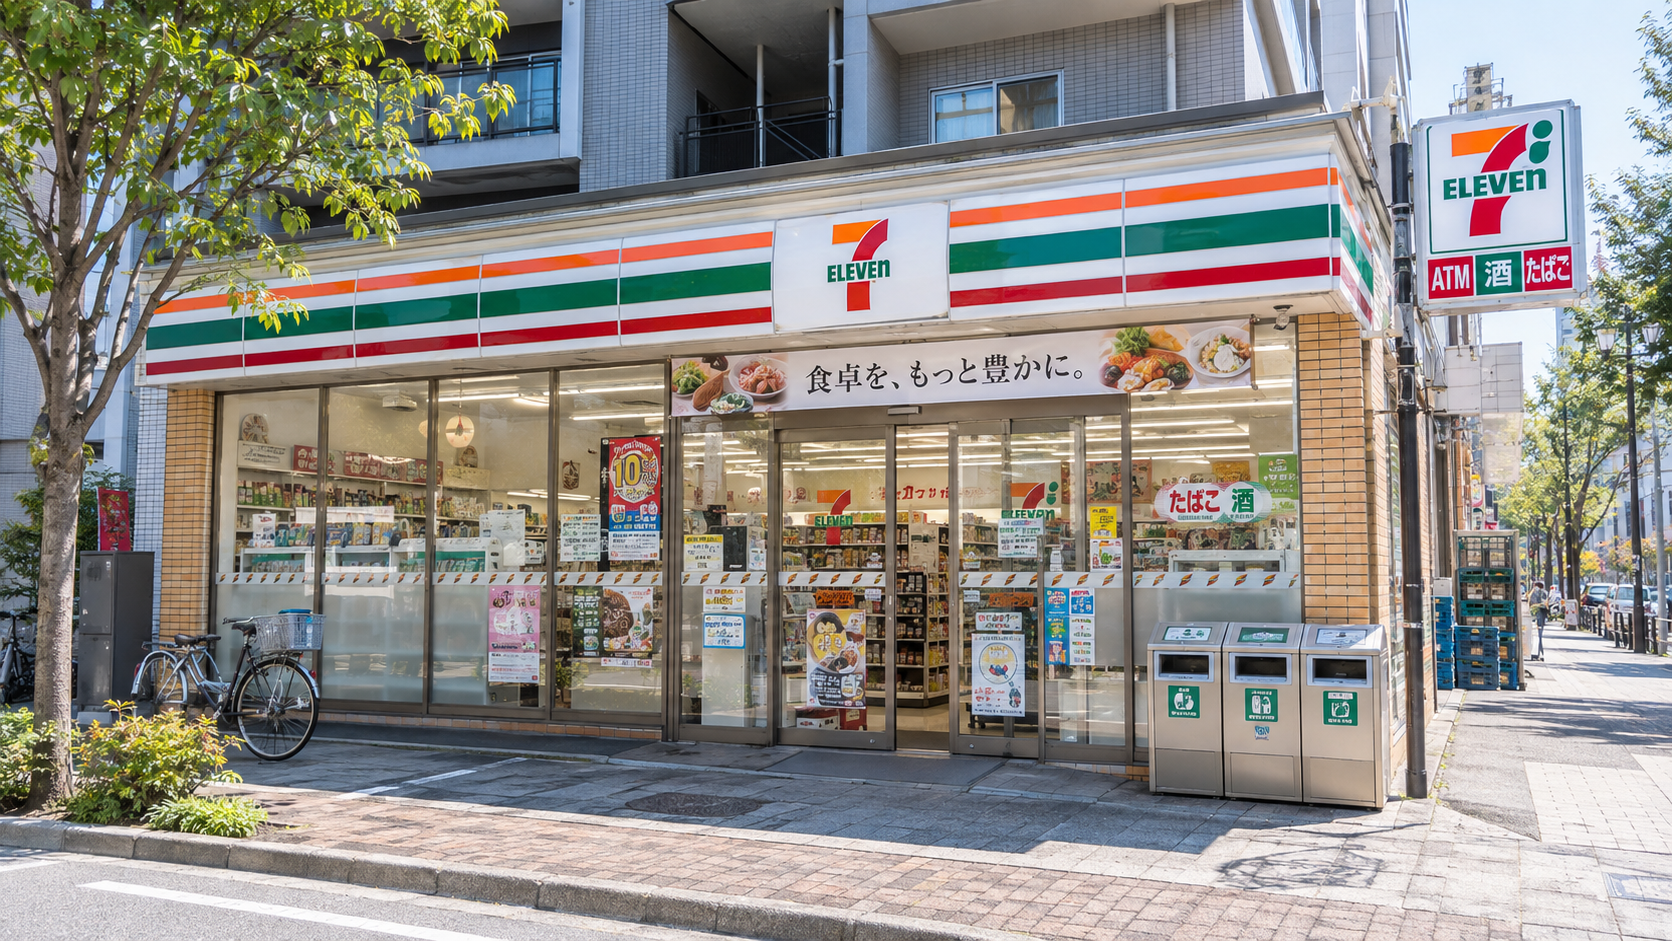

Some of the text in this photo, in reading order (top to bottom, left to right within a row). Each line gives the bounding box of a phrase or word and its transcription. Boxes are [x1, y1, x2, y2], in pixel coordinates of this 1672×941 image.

[1452, 123, 1529, 237] 7
[832, 218, 889, 312] 7
[1431, 264, 1470, 291] ATM
[1485, 259, 1512, 287] 酒
[805, 354, 1083, 395] 食卓を、もっと豊かに。
[1169, 488, 1255, 514] たばこ 酒
